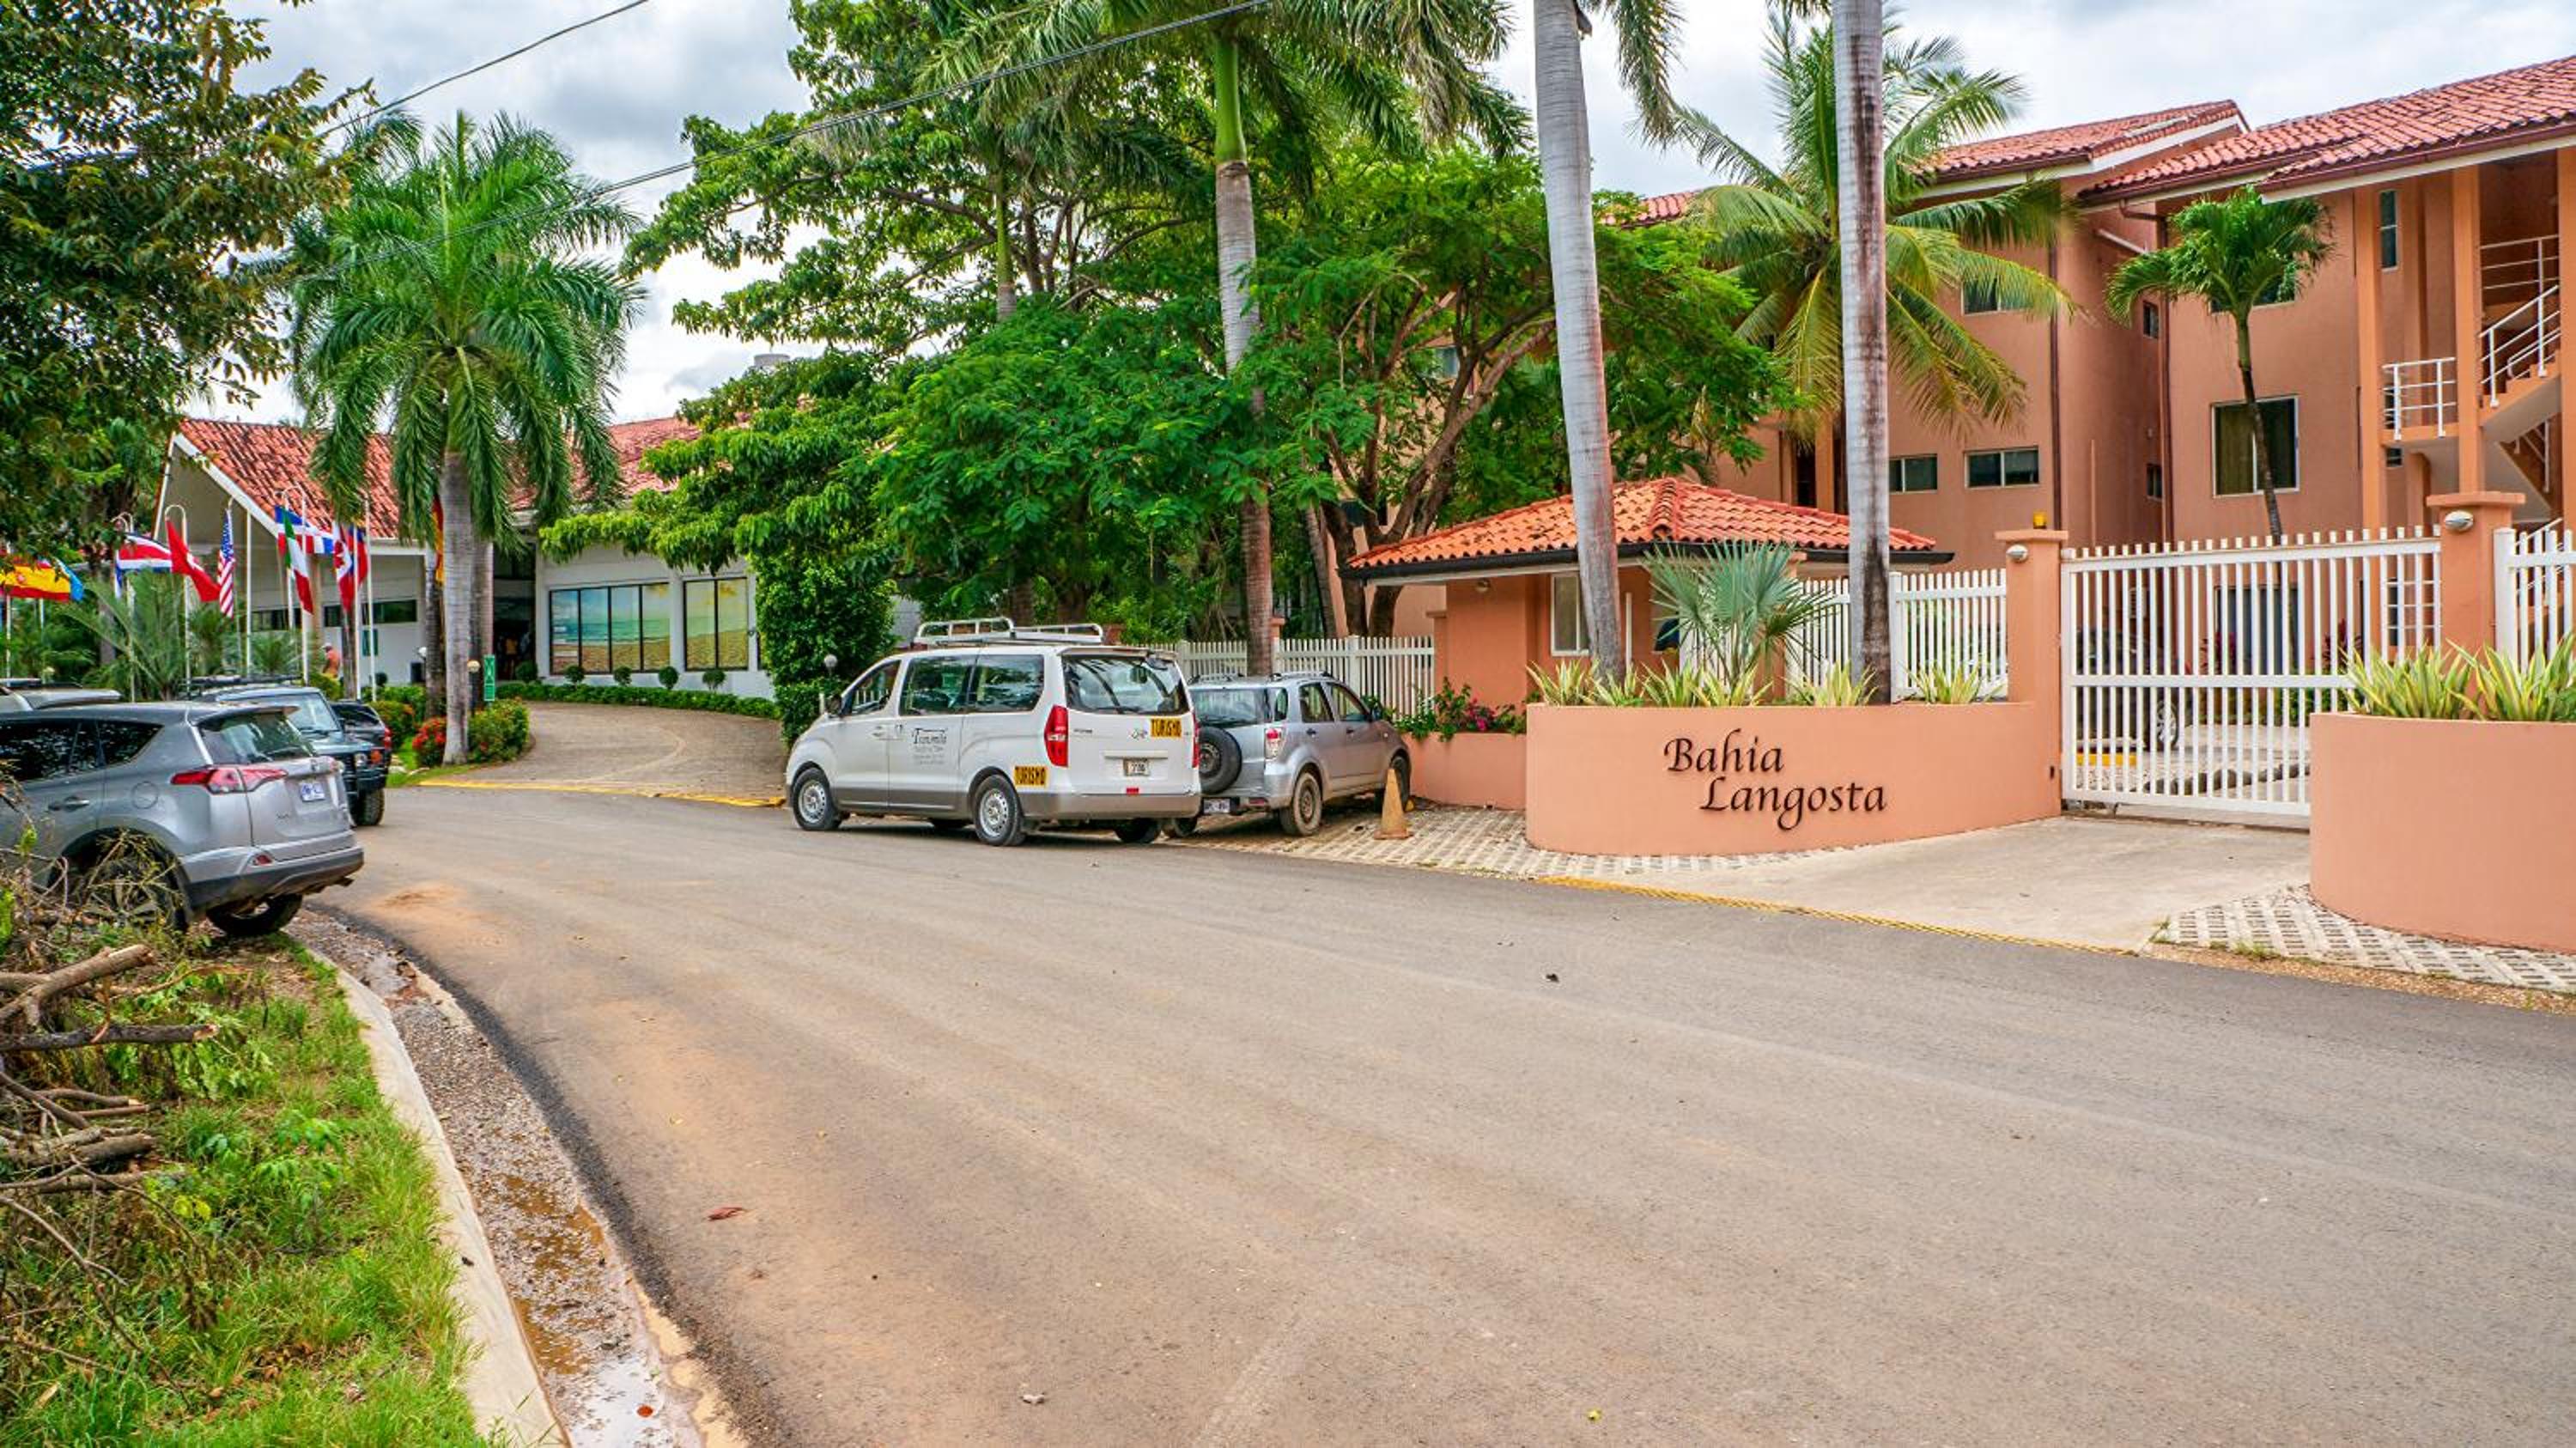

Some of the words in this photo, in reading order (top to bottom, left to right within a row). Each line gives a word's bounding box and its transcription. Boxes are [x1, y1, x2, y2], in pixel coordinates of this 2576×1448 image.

[1151, 718, 1182, 737] TURISMO
[1015, 766, 1045, 785] TURISMO
[1699, 776, 1886, 830] Langosta
